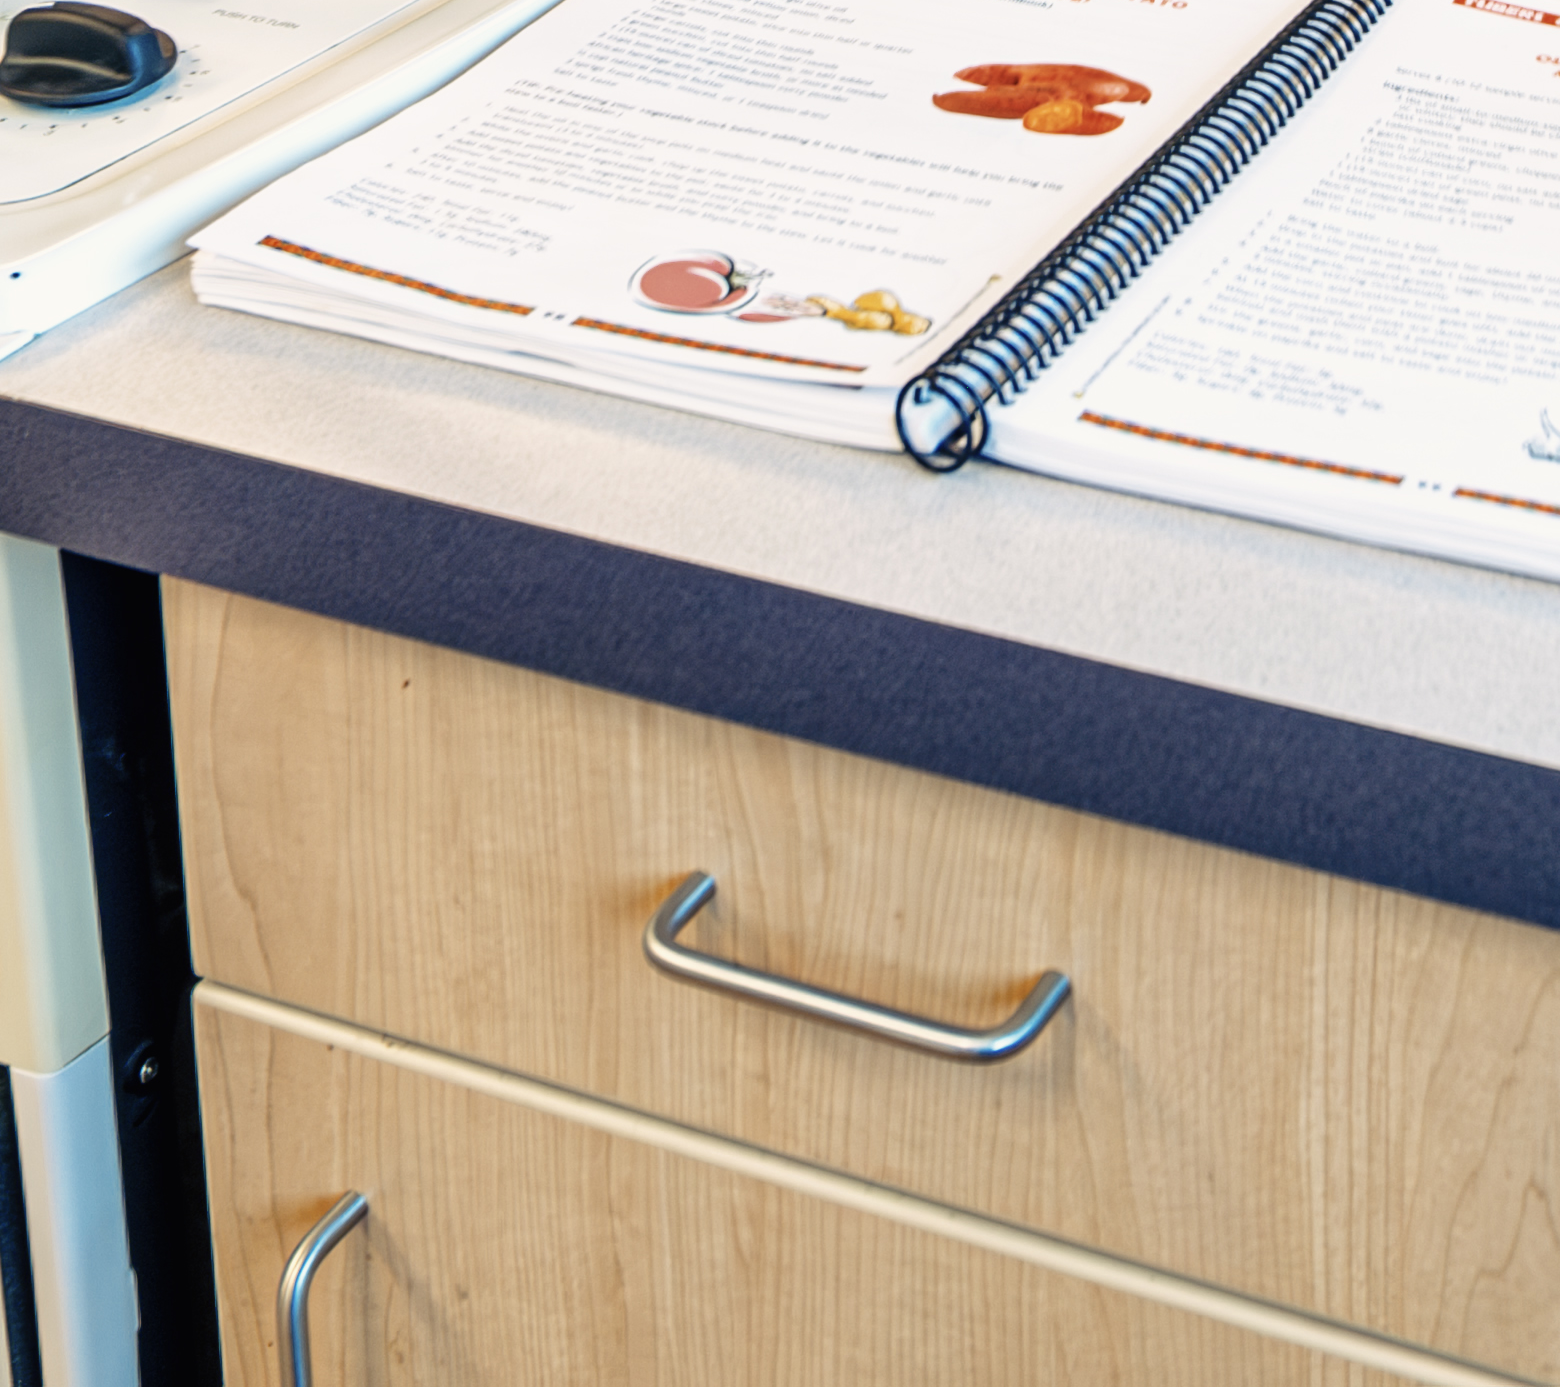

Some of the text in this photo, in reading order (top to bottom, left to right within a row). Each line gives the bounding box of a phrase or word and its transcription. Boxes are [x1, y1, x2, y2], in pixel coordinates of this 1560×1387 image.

[212, 8, 301, 30] PUSH TO TURN
